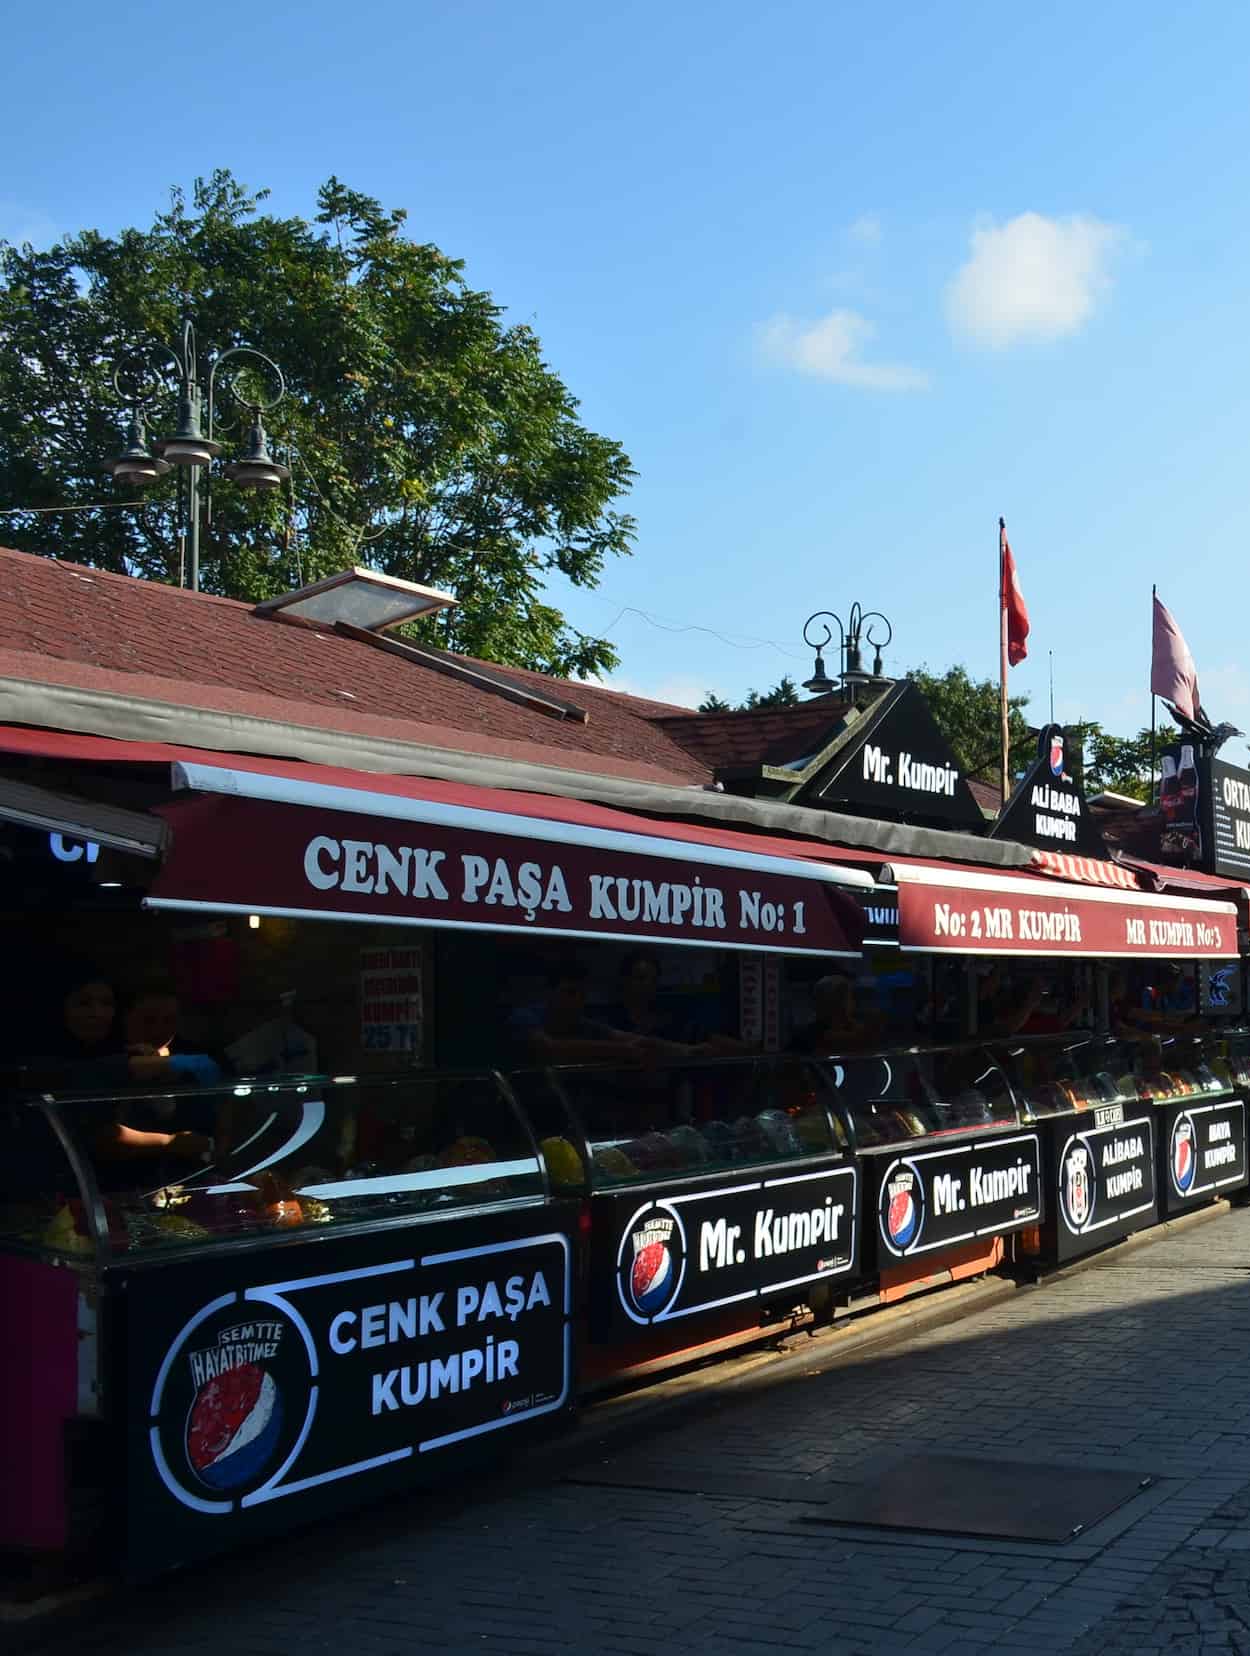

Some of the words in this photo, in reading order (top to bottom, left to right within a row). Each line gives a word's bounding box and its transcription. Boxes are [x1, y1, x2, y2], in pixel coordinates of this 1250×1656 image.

[862, 742, 894, 785] Mr.
[898, 751, 961, 797] Kumpir
[1035, 813, 1078, 843] KUMPİR
[303, 835, 449, 900] CENK
[461, 861, 573, 922] PAŞA
[588, 875, 727, 930] KUMPİR
[737, 894, 786, 933] No:
[984, 906, 1014, 939] MR
[1018, 906, 1082, 944] KUMPİR
[1126, 917, 1147, 943] MR
[1149, 915, 1195, 947] KUMPİR
[1205, 1140, 1237, 1169] KUMPİR
[932, 1172, 967, 1217] Mr.
[969, 1156, 1032, 1208] Kumpir
[1105, 1164, 1144, 1200] KUMPİR
[699, 1216, 746, 1272] Mr.
[754, 1195, 846, 1260] Kumpir
[221, 1322, 284, 1344] SEMTTE
[328, 1290, 446, 1357] CENK
[456, 1269, 553, 1324] PAŞA
[371, 1335, 521, 1418] KUMPİR
